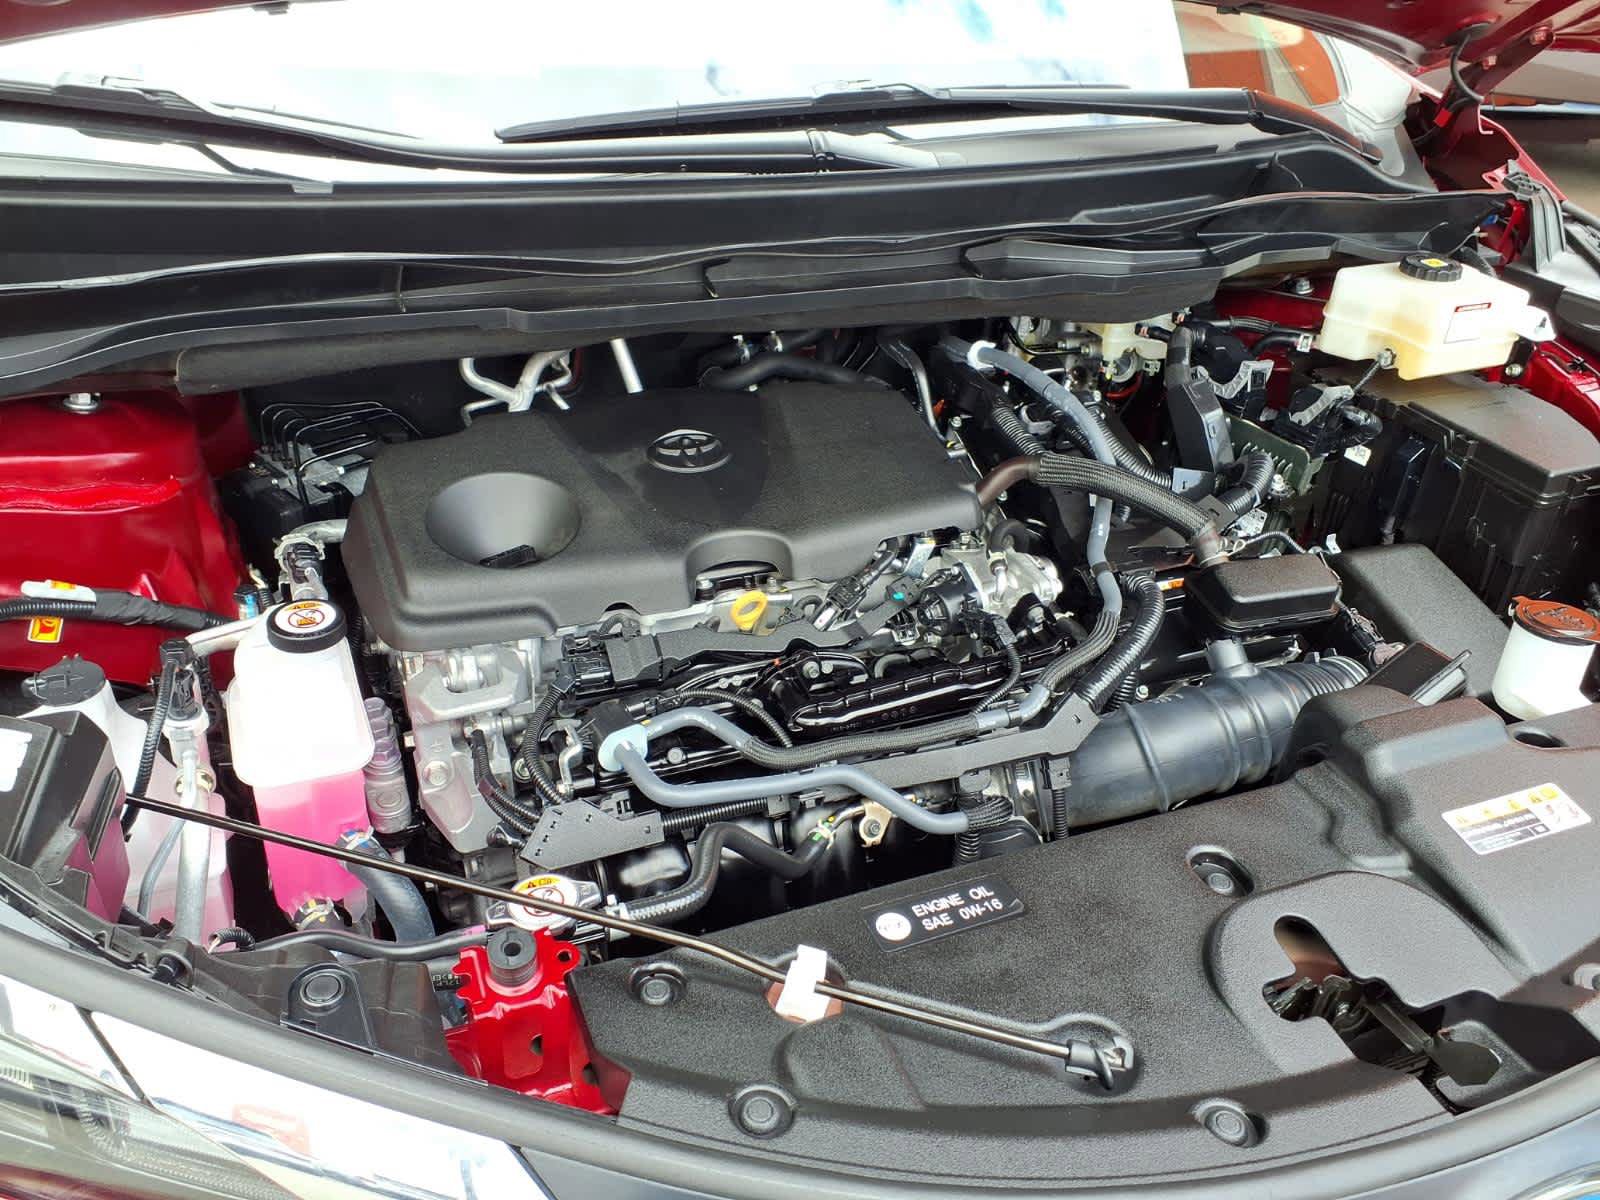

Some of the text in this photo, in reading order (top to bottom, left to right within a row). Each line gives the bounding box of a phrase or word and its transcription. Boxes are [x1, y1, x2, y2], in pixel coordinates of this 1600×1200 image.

[912, 886, 995, 917] ENGINE OIL
[922, 912, 954, 931] SAE
[959, 899, 1004, 920] 0W-16
